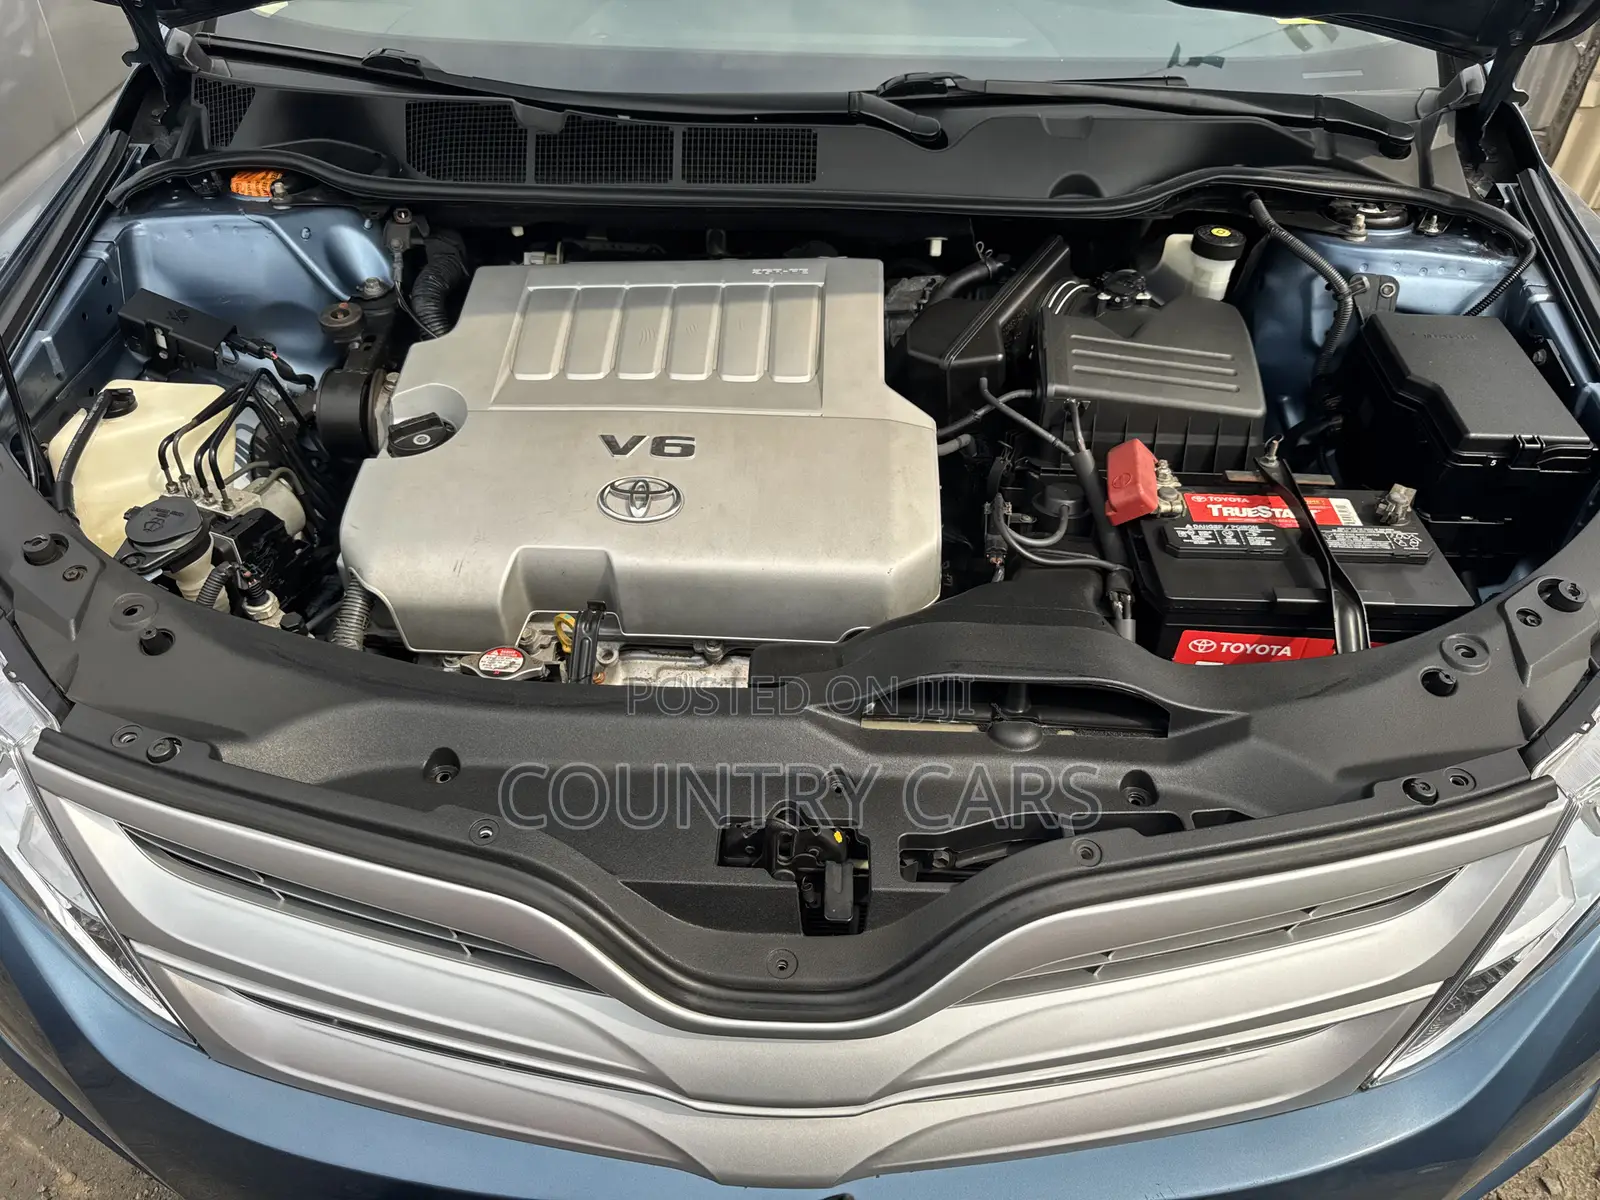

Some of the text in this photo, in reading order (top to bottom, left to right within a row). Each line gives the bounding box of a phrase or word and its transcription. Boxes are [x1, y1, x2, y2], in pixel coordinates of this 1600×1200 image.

[598, 433, 697, 460] V6
[1207, 496, 1250, 504] TOYOTA
[1206, 503, 1319, 519] TRUESTAT
[1219, 641, 1292, 657] TOYOTA
